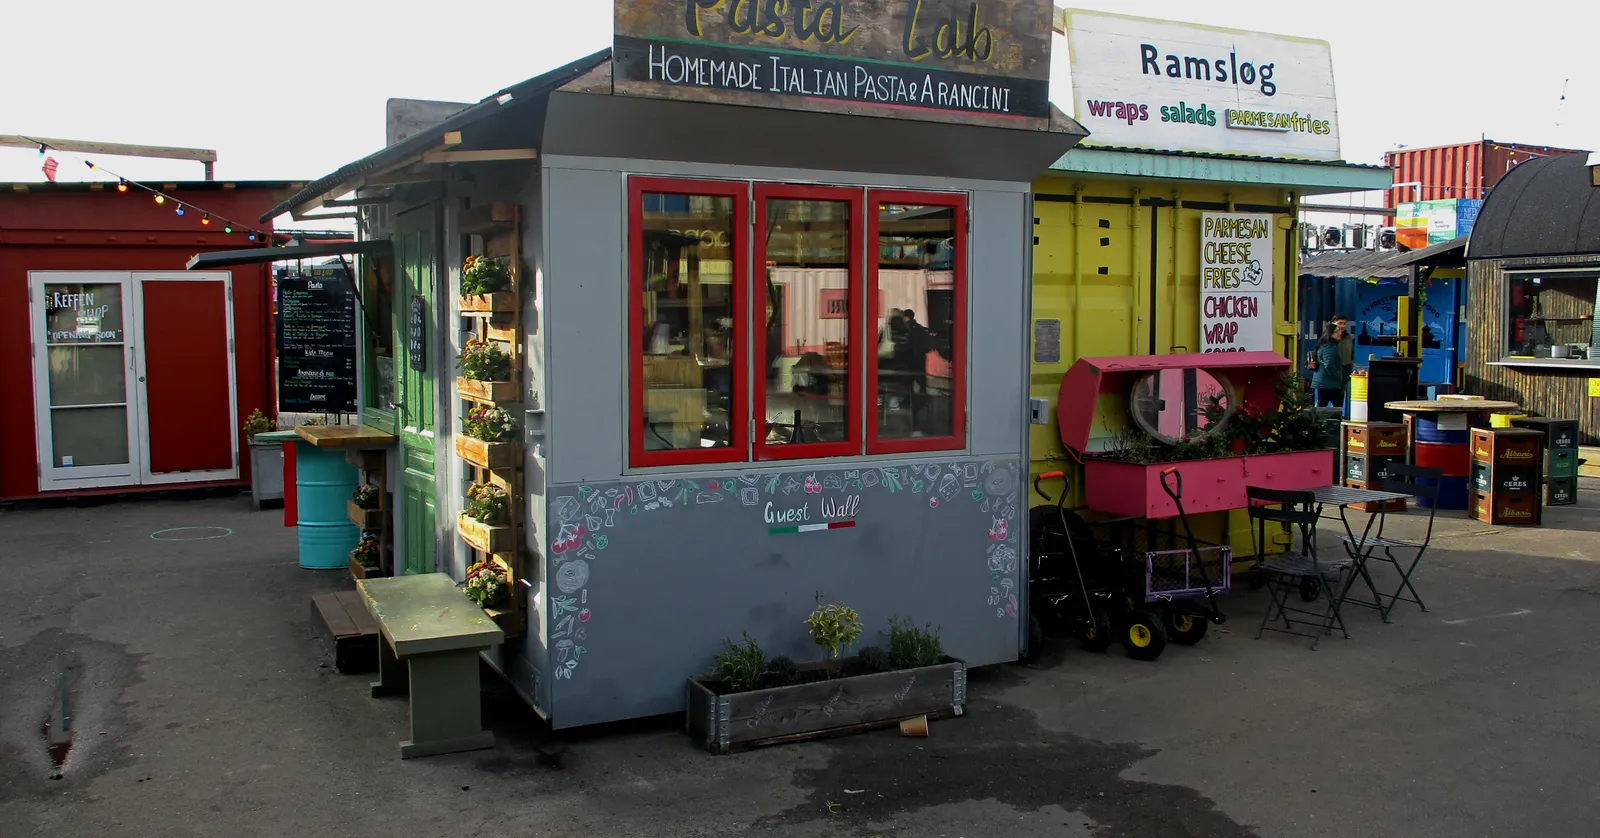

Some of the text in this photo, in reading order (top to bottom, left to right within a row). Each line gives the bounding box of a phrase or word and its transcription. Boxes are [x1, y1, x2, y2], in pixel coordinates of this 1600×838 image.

[648, 44, 762, 90] HOMEMADE
[769, 56, 849, 98] ITALIAN
[1140, 43, 1277, 97] Ramsløg
[1087, 99, 1149, 125] wraps
[1160, 101, 1217, 127] salads
[1204, 217, 1269, 239] PARMESAN
[1204, 241, 1252, 265] CHEESE
[1204, 267, 1241, 289] FRIES
[54, 291, 95, 311] REFFEN
[1203, 295, 1258, 319] CHICKEN
[1203, 321, 1239, 345] WRAP
[1500, 448, 1533, 459] Albani
[764, 494, 860, 523] Guest Wall
[1499, 507, 1531, 518] Albani
